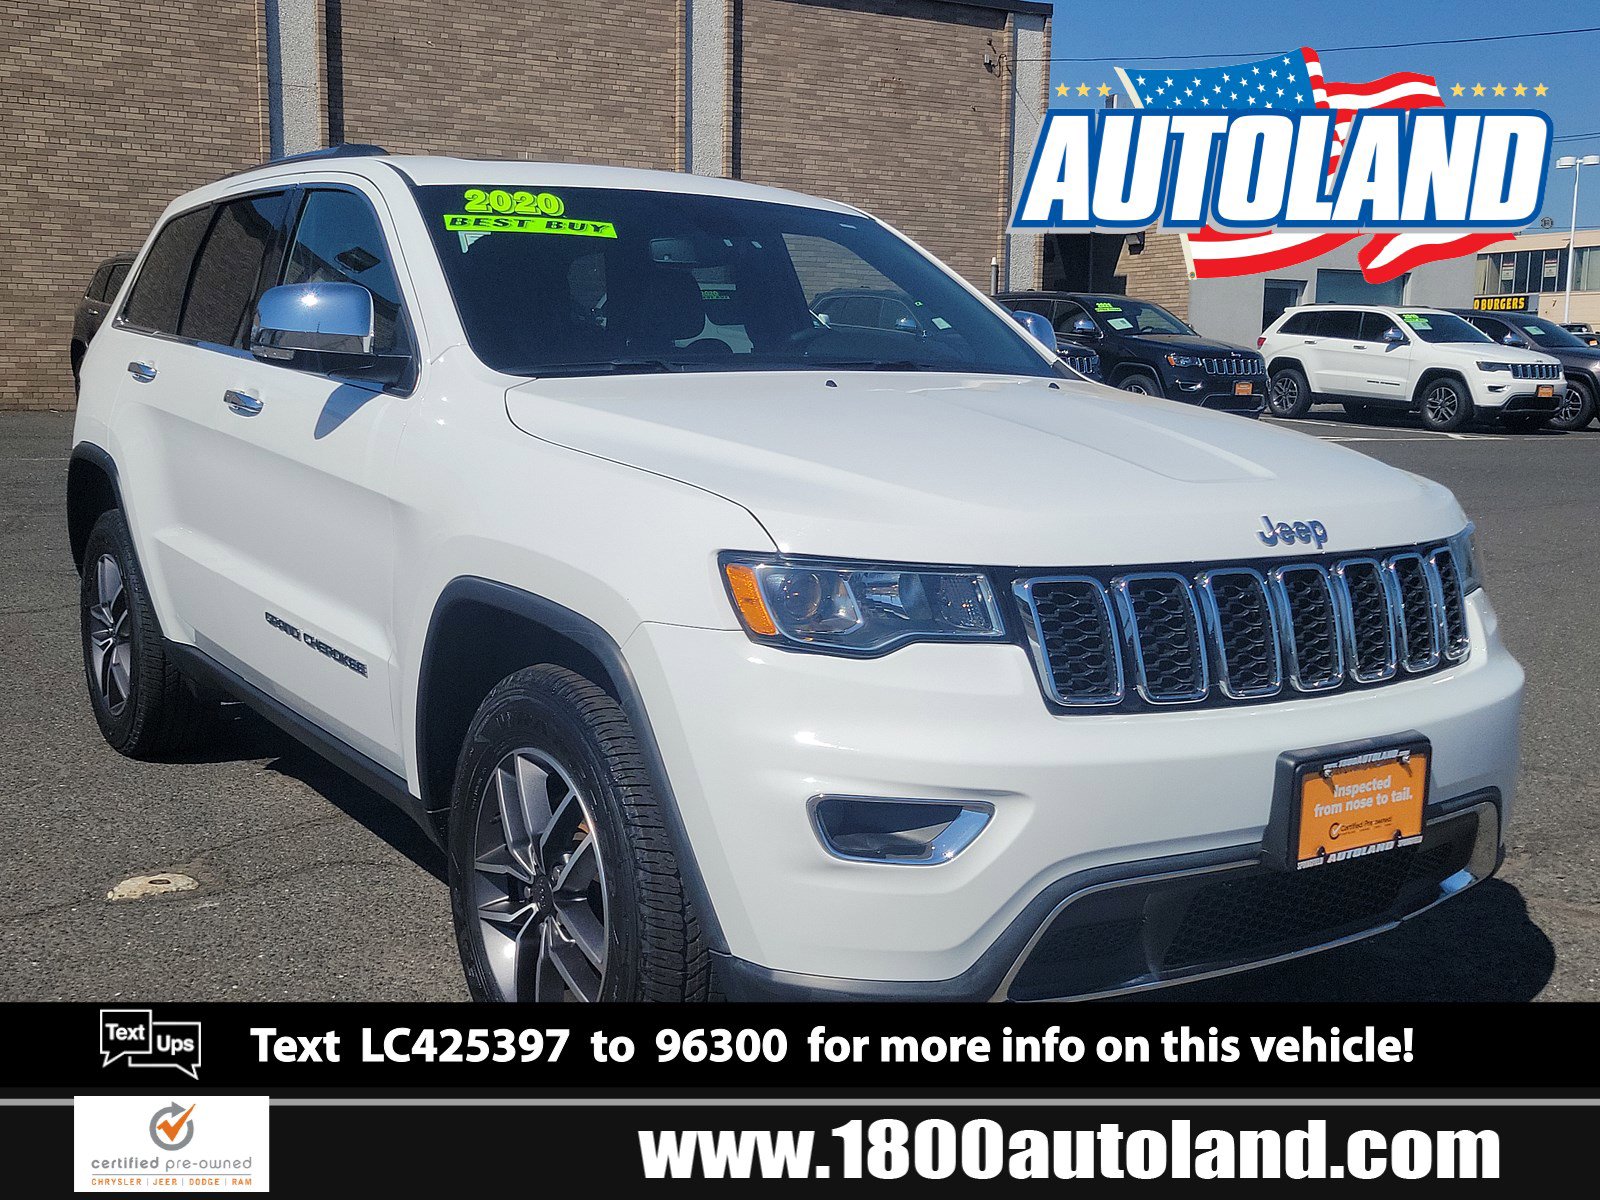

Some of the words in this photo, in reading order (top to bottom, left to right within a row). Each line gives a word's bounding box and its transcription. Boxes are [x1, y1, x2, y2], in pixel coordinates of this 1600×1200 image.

[464, 189, 565, 216] 2020
[449, 217, 534, 229] BEST
[545, 220, 611, 235] BUY
[1481, 297, 1526, 311] BURGERS
[1255, 515, 1329, 550] Jeep
[1333, 775, 1392, 798] Inspected
[1314, 803, 1343, 818] from
[1345, 796, 1373, 811] nose
[1376, 793, 1389, 806] to
[1391, 786, 1413, 803] tail.
[1327, 840, 1396, 863] AUTOLAND
